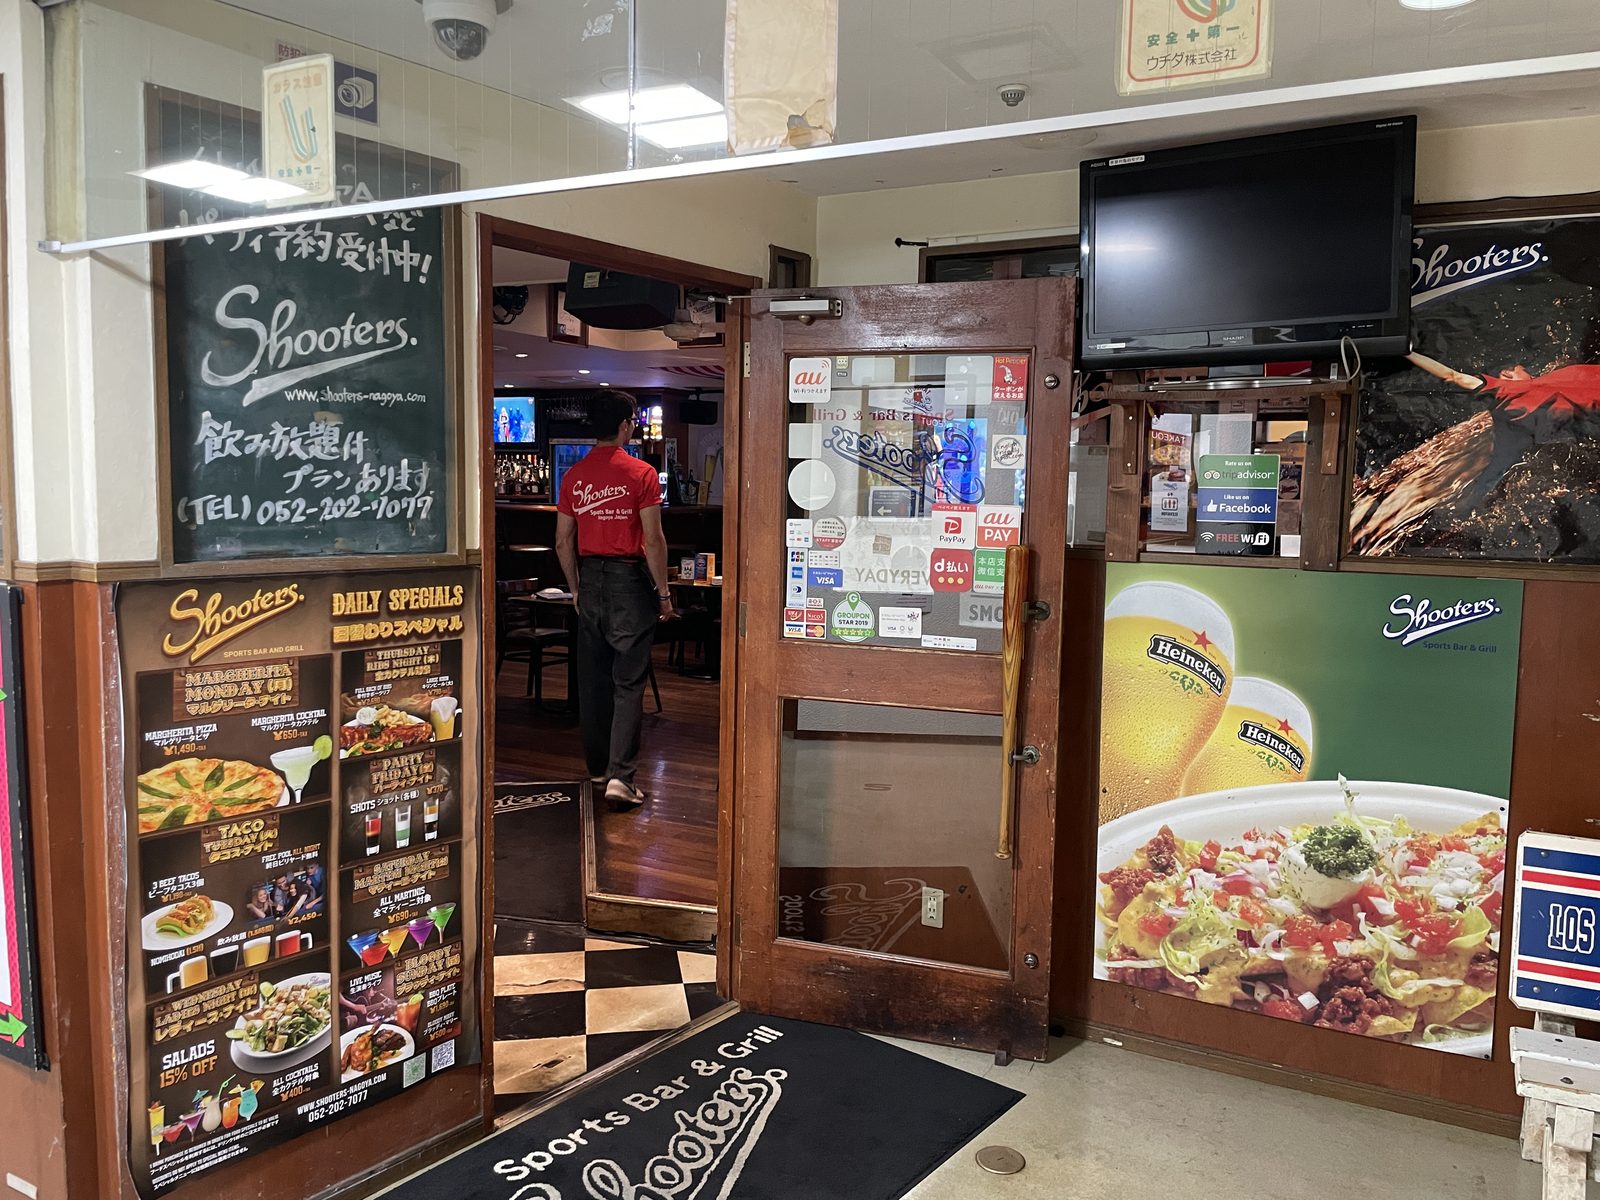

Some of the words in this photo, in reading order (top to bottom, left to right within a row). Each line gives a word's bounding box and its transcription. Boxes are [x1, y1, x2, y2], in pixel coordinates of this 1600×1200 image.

[1147, 31, 1178, 48] 安全
[1207, 25, 1240, 40] 第一
[1146, 48, 1238, 71] ウチダ株式会社
[178, 207, 433, 285] パティ予約受付中!
[794, 371, 827, 385] au
[284, 386, 426, 408] www.shooters-nagoya.com
[177, 494, 251, 525] (TEL)
[256, 495, 434, 525] 052-202-7077
[983, 512, 1015, 525] au
[1219, 503, 1271, 514] Facebook
[939, 535, 966, 543] PayPay
[984, 529, 1012, 542] PAY
[1216, 533, 1239, 543] FREE
[934, 558, 969, 573] d払い
[977, 567, 1005, 577] 微信支
[816, 576, 835, 585] VISA
[332, 590, 382, 616] DAILY
[388, 584, 464, 611] SPECIALS
[837, 612, 870, 620] GROUPON
[968, 604, 1004, 623] SMO
[332, 615, 463, 644] 日替わりスペシャル
[223, 649, 252, 658] SPORTS
[253, 647, 269, 656] BAR
[269, 646, 284, 654] AND
[284, 644, 305, 653] GRILL
[377, 645, 430, 660] THURSDAY
[1423, 641, 1451, 650] Sports
[1452, 642, 1468, 651] Bar
[1469, 644, 1477, 652] &
[1478, 645, 1497, 653] Grill
[392, 657, 422, 669] NIGHT
[1156, 640, 1222, 690] Heineken
[185, 663, 292, 688] MARGHERITA
[185, 680, 265, 703] MONDAY
[251, 712, 295, 727] MARGHERITA
[295, 708, 328, 719] COCKTAIL
[145, 726, 194, 742] MARGHERITA
[195, 723, 218, 735] PIZZA
[1245, 725, 1302, 768] Heineken
[382, 750, 425, 771] PARTY
[370, 763, 420, 785] FRIDAY
[350, 799, 376, 814] SHOTS
[217, 818, 265, 839] TACO
[203, 832, 259, 853] TUESDAY
[261, 852, 277, 864] FREE
[277, 850, 293, 861] POOL
[373, 850, 432, 875] SATURDAY
[158, 876, 177, 888] BEEF
[177, 871, 200, 884] TACOS
[379, 896, 393, 907] ALL
[394, 886, 426, 903] MARTINIS
[1547, 903, 1596, 955] LOS
[349, 976, 364, 988] LIVE
[364, 970, 383, 983] MUSIC
[396, 958, 445, 985] SUNDAY
[162, 1039, 216, 1071] SALADS
[159, 1063, 188, 1089] 15%
[192, 1055, 218, 1078] OFF
[272, 1076, 284, 1087] ALL
[285, 1062, 319, 1083] COCKTAILS
[297, 1072, 387, 1116] WWW.SHOOTERS-NAGOYA.COM
[494, 1109, 631, 1182] Sports
[622, 1074, 690, 1113] Bar
[690, 1058, 726, 1078] &
[717, 1024, 784, 1060] Grill
[308, 1089, 368, 1123] 052-202-7077
